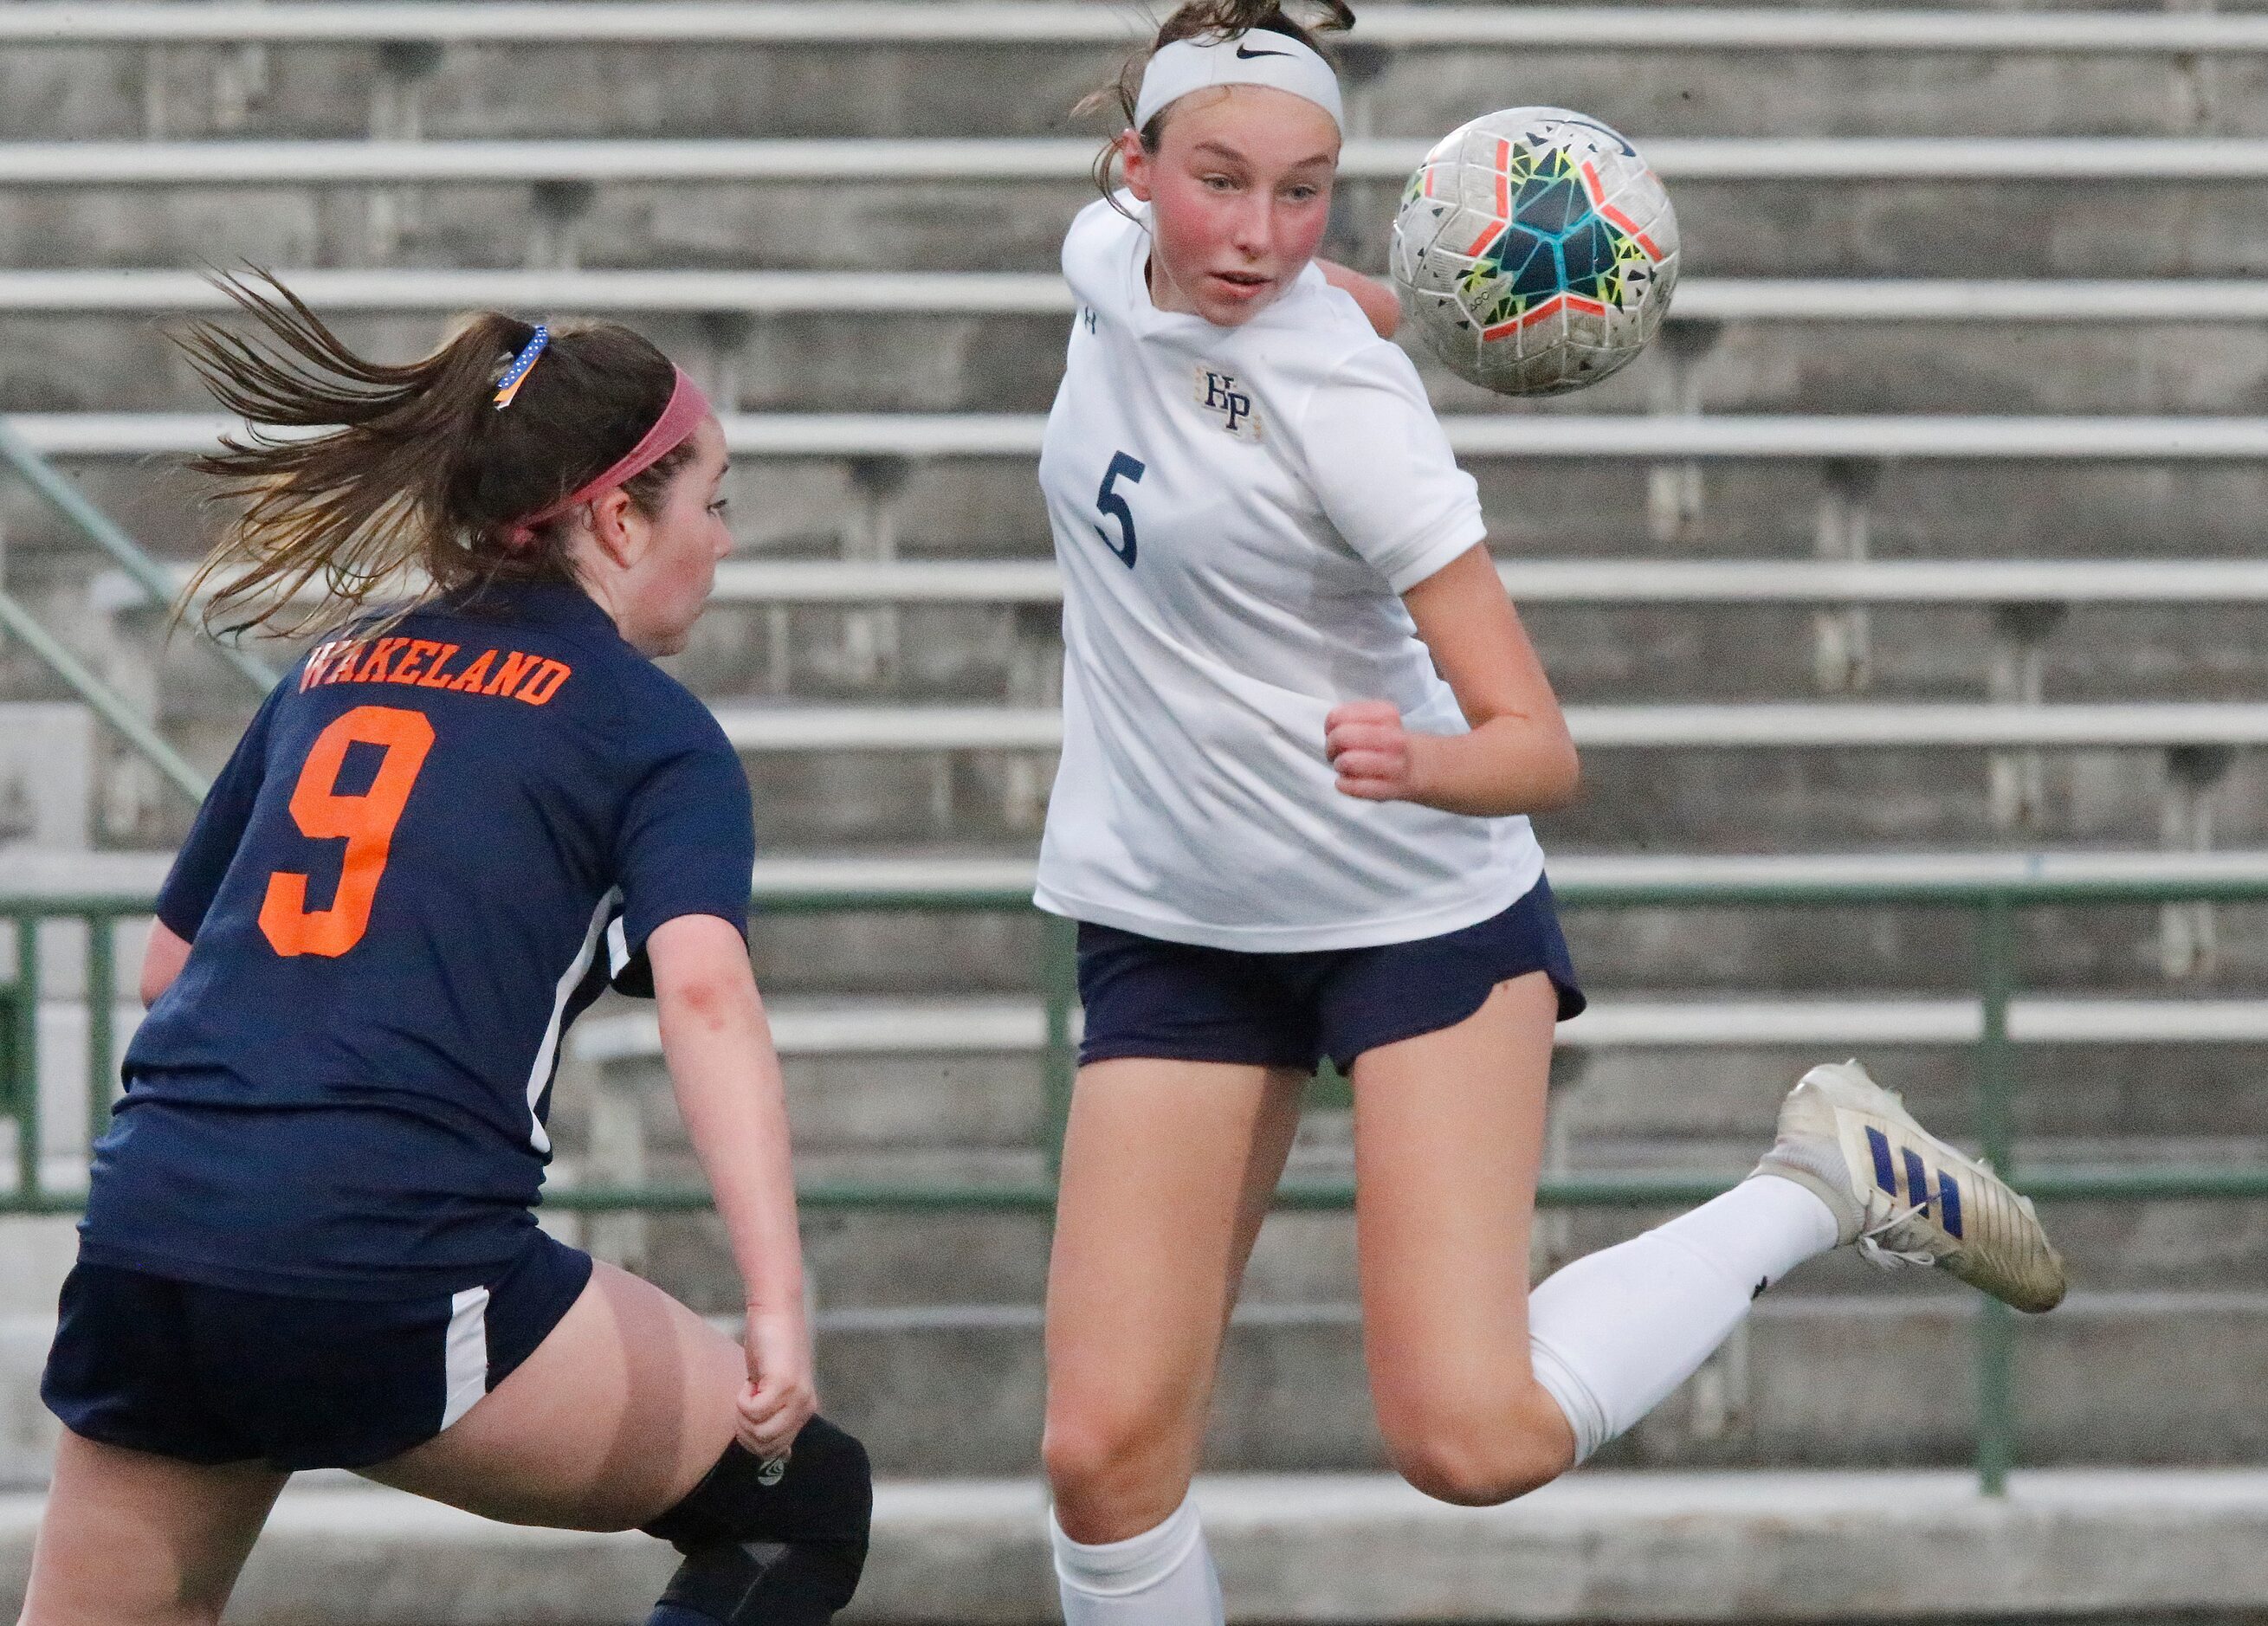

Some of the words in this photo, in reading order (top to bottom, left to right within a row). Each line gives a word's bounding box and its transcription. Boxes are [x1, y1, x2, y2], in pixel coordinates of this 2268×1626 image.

[1205, 371, 1250, 430] HP
[1094, 450, 1146, 570] 5
[299, 637, 572, 706] WAKELAND
[257, 706, 436, 958] 9
